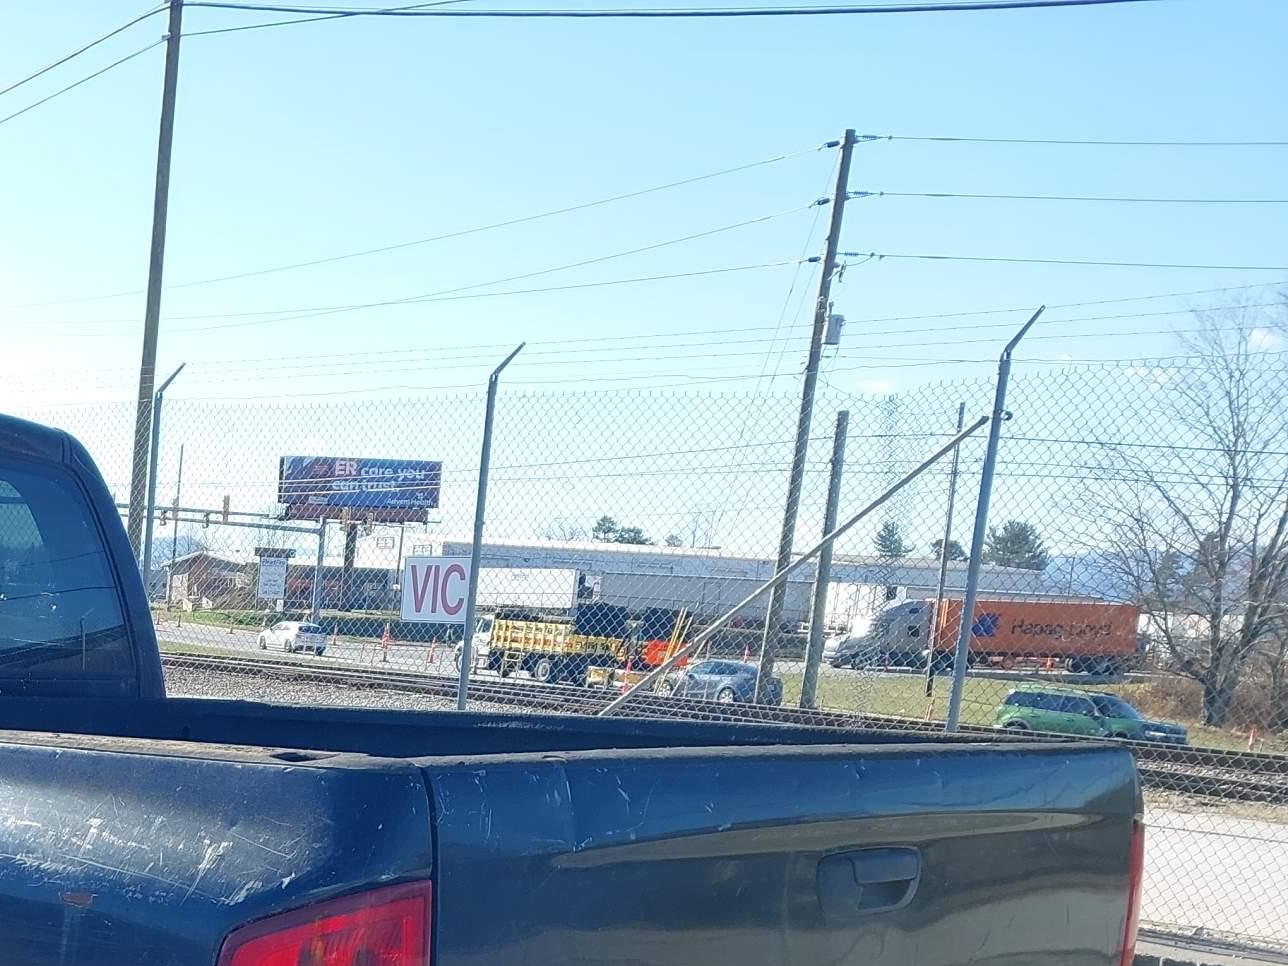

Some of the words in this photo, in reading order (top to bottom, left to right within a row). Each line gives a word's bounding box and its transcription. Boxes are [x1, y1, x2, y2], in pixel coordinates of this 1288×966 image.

[335, 460, 358, 476] ER
[361, 466, 393, 476] care
[398, 467, 425, 481] you
[410, 563, 466, 616] VIC
